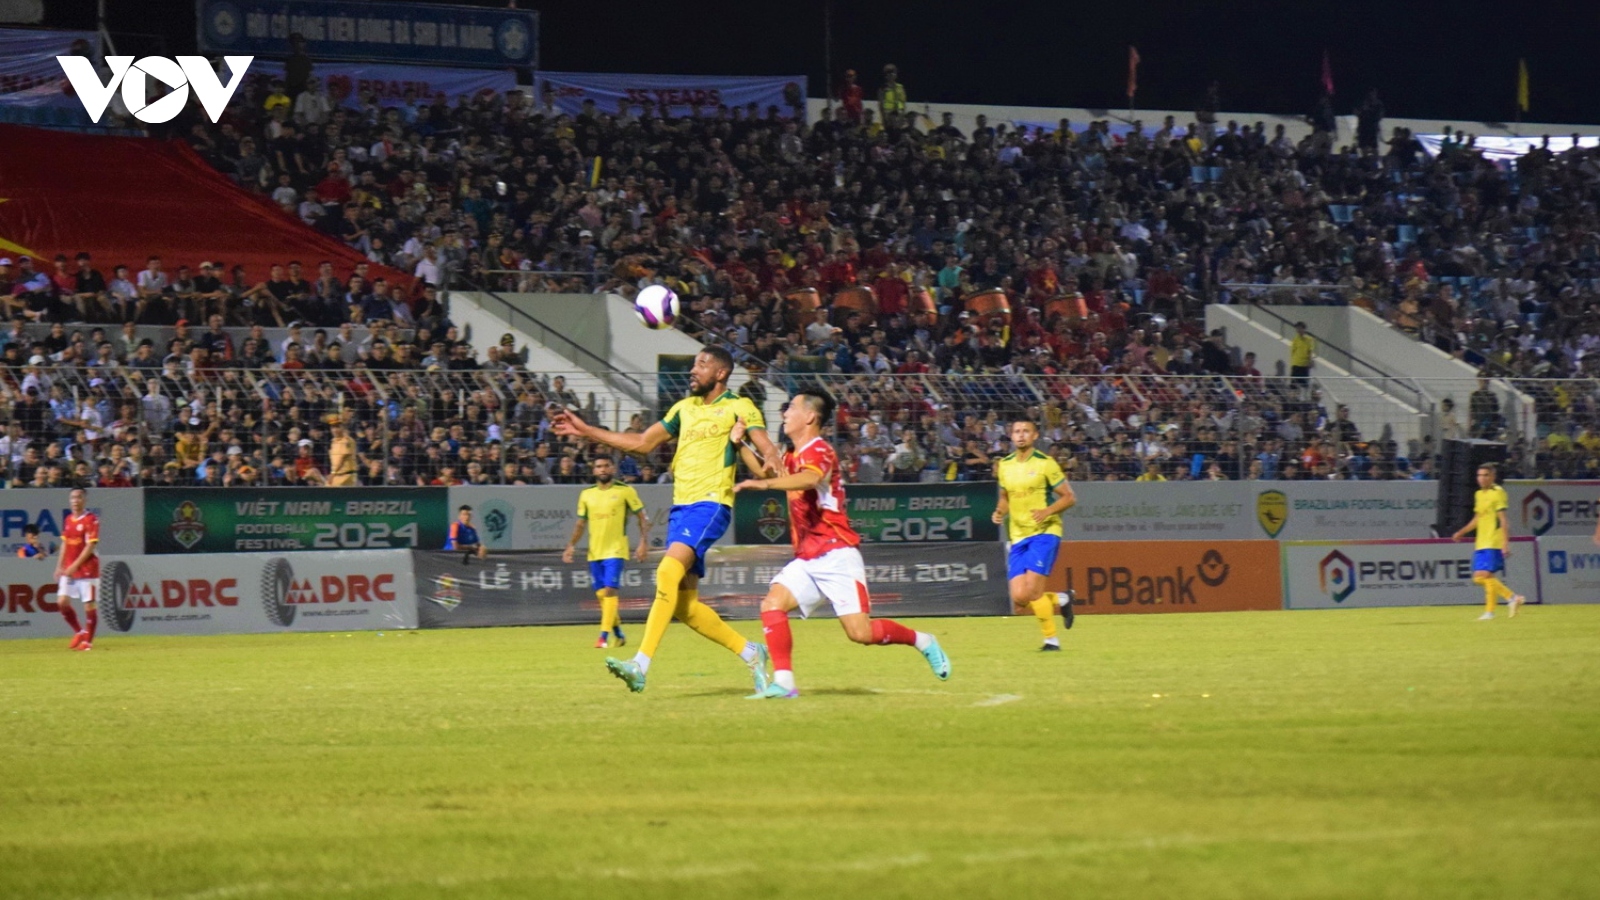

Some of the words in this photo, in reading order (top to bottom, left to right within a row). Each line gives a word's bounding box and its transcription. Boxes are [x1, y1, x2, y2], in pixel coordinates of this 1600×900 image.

[283, 500, 332, 516] NAM
[345, 500, 418, 516] BRAZIL
[854, 497, 898, 511] NAM
[908, 495, 971, 511] BRAZIL
[1293, 499, 1350, 510] BRAZILIAN
[1351, 499, 1404, 510] FOOTBALL
[524, 509, 574, 520] FURAMA
[235, 523, 310, 535] FOOTBALL
[313, 521, 419, 549] 2024
[880, 516, 974, 543] 2024
[235, 538, 303, 550] FESTIVAL
[913, 562, 988, 583] 2024
[161, 578, 240, 609] DRC
[320, 573, 397, 604] DRC
[1064, 565, 1198, 606] LPBank
